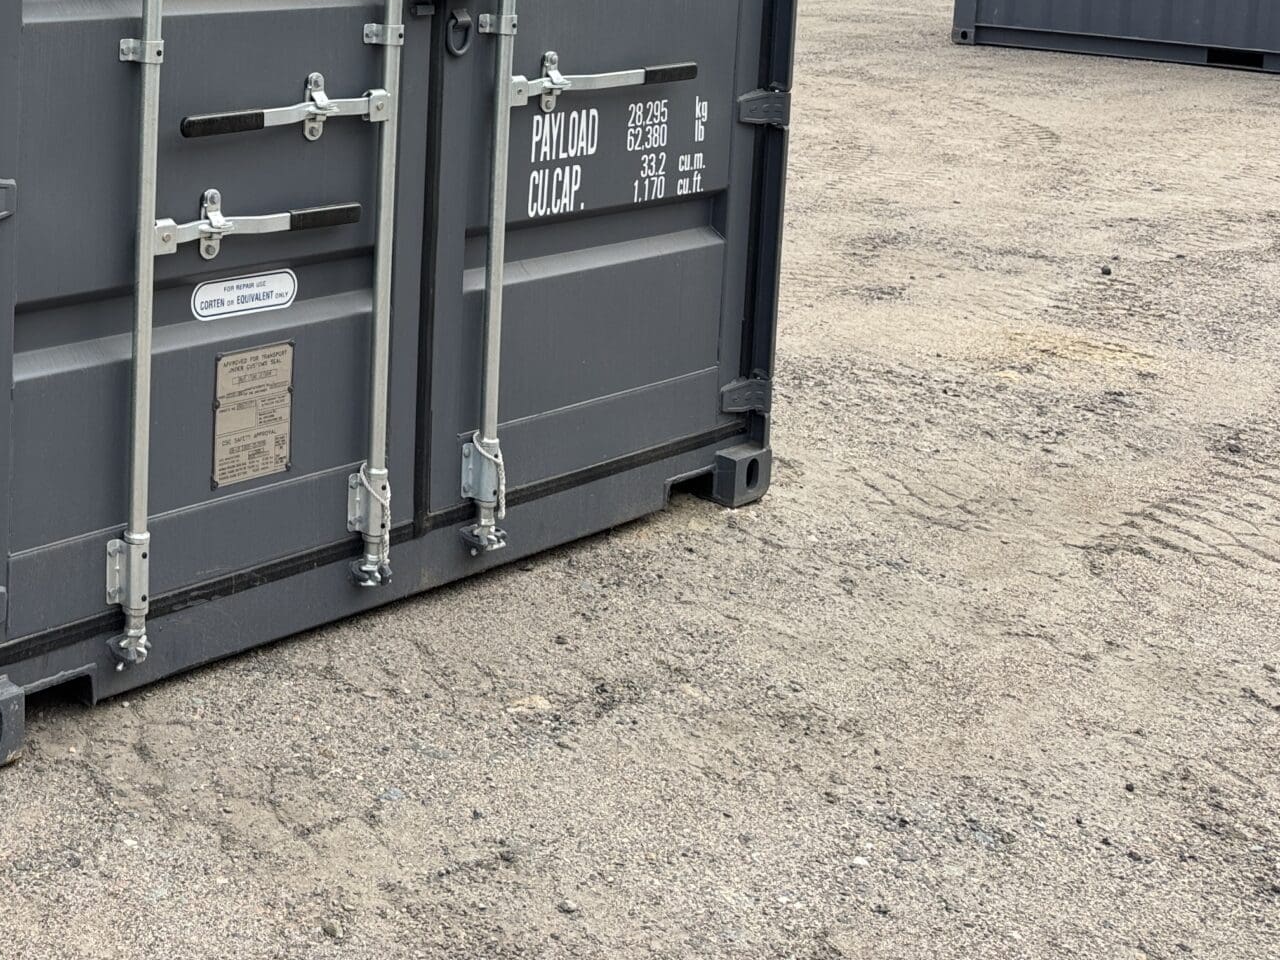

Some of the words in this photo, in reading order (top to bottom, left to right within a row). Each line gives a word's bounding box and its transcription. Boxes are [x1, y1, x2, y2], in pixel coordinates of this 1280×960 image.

[530, 108, 599, 163] PAYLOAD
[628, 99, 668, 128] 28,295
[695, 96, 708, 122] kg
[626, 124, 668, 152] 62,380
[694, 119, 705, 142] lb
[640, 152, 667, 178] 33.2
[678, 152, 706, 173] cu.m.
[677, 171, 704, 196] cu.ft.
[236, 282, 255, 291] REPAIR
[256, 280, 266, 288] USE
[200, 298, 225, 311] CORTEN
[236, 290, 274, 305] EQUIVALENT
[274, 291, 289, 299] ONLY
